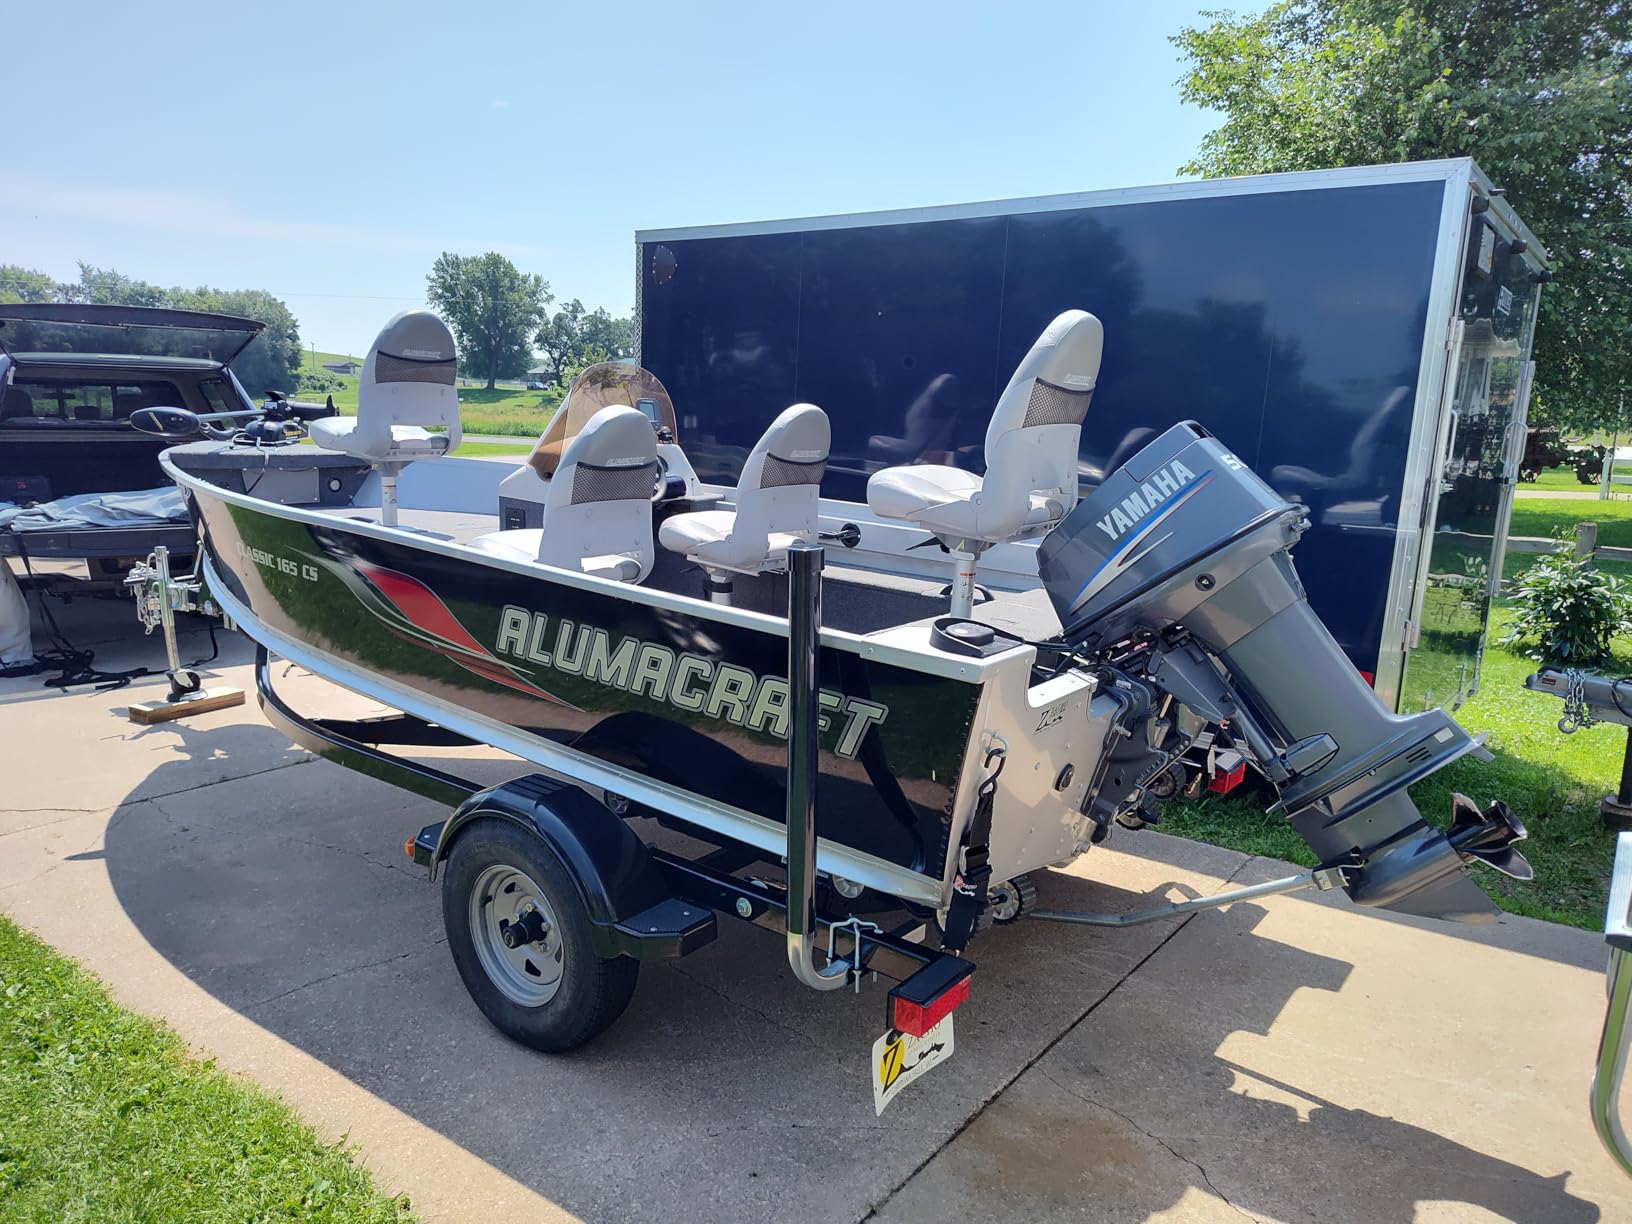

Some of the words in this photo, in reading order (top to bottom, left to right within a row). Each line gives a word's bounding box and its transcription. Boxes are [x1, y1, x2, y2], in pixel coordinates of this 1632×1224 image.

[1095, 459, 1196, 541] YAMAHA
[277, 557, 298, 576] 165
[302, 564, 319, 582] CS
